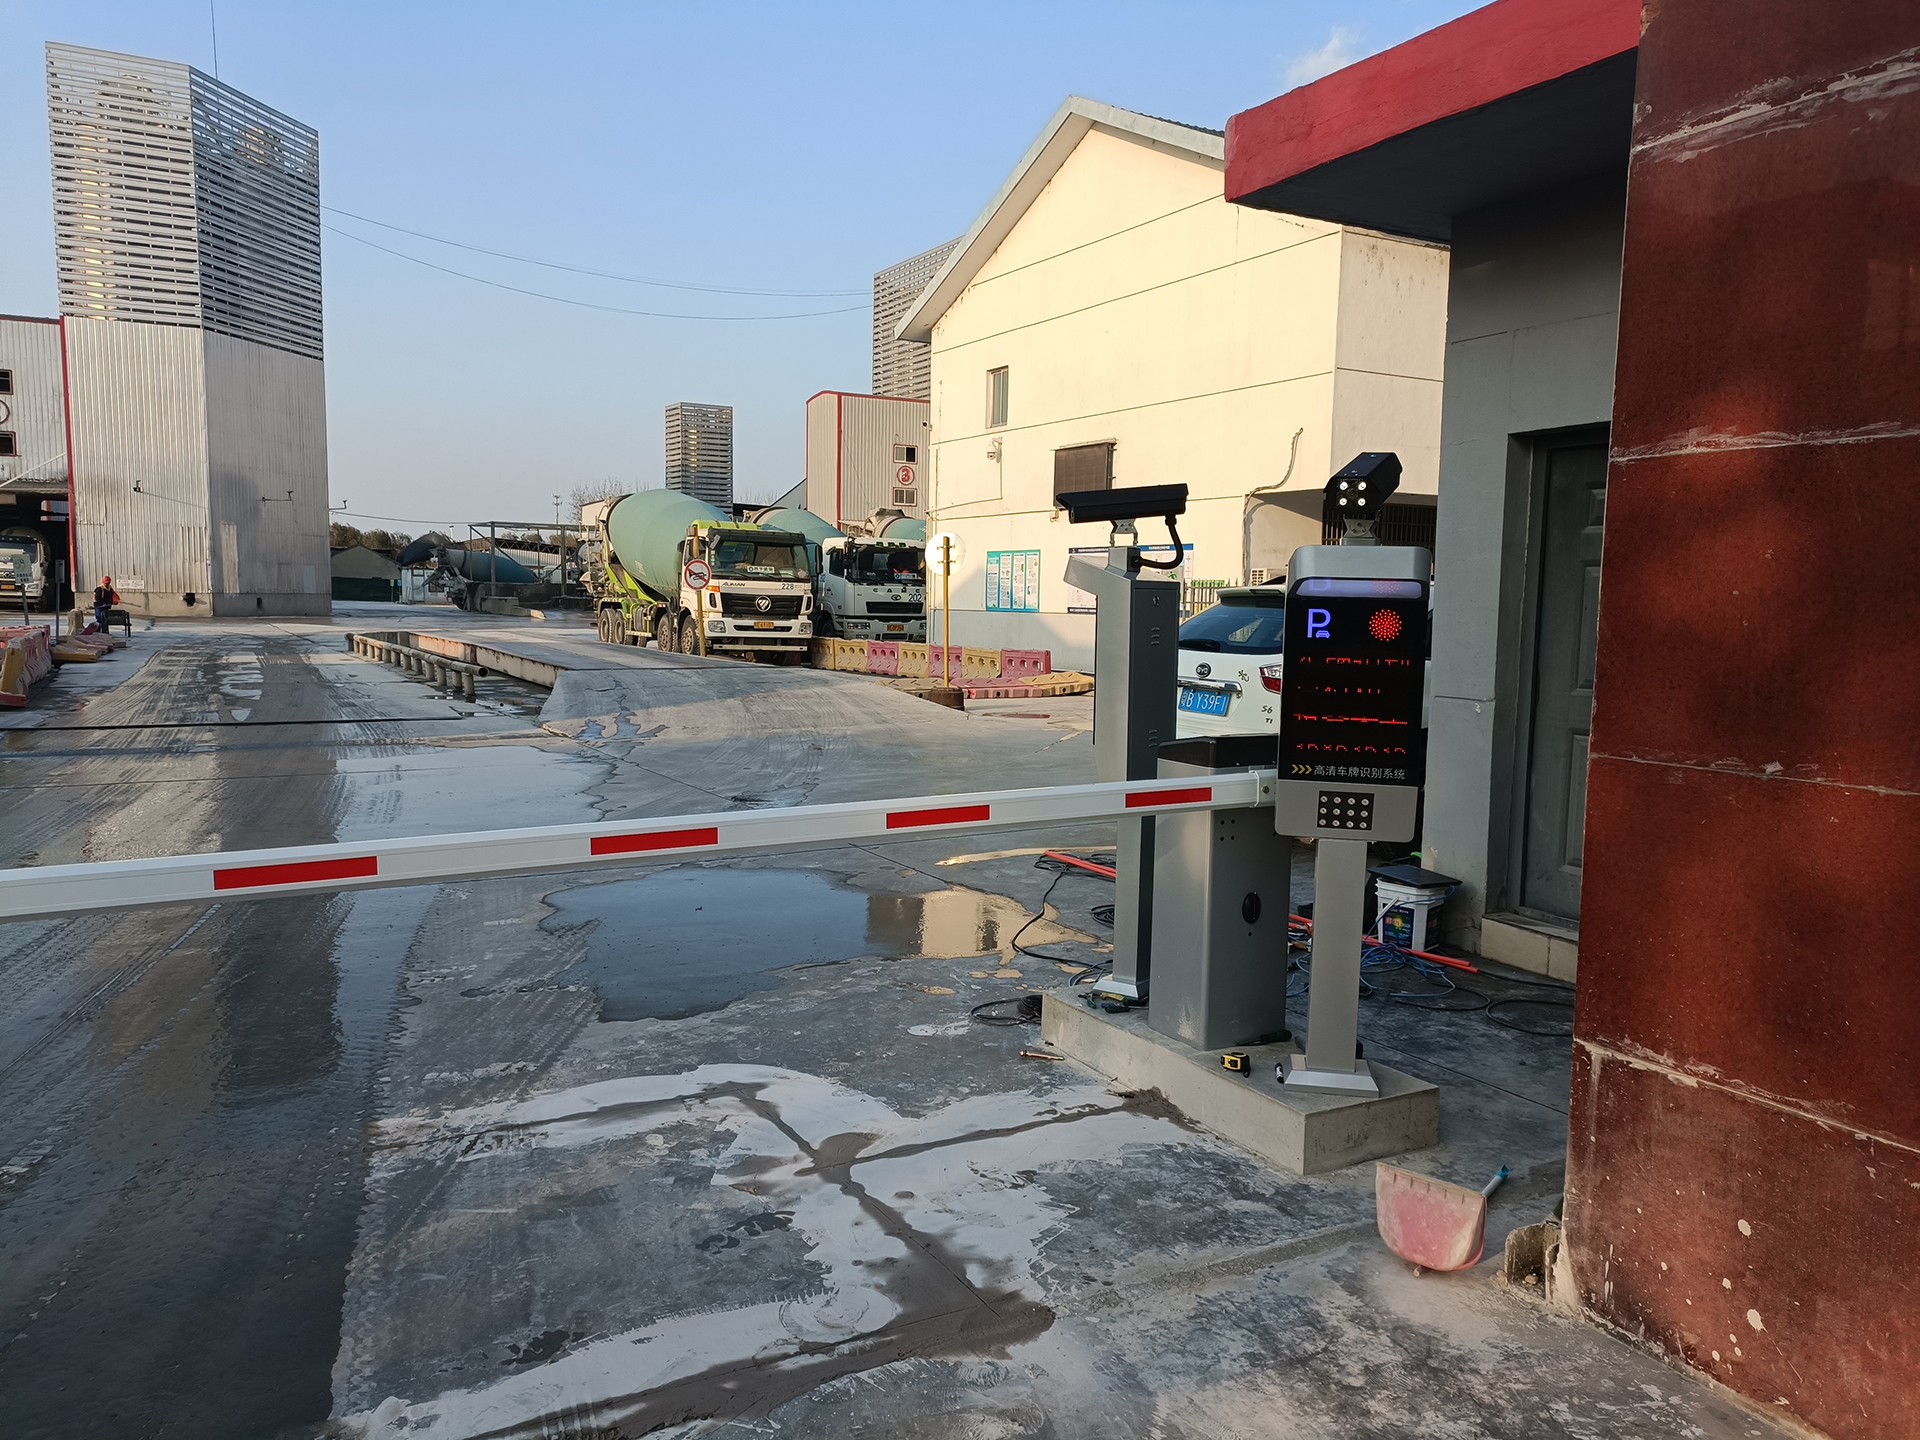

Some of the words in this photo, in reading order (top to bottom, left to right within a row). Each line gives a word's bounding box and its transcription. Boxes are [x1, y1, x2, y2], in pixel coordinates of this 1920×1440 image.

[902, 468, 910, 482] 3
[909, 593, 921, 602] 202
[1307, 608, 1331, 638] P
[1197, 666, 1208, 674] BYD
[1261, 705, 1273, 714] S6
[1313, 764, 1406, 780] 高清车牌识别系统
